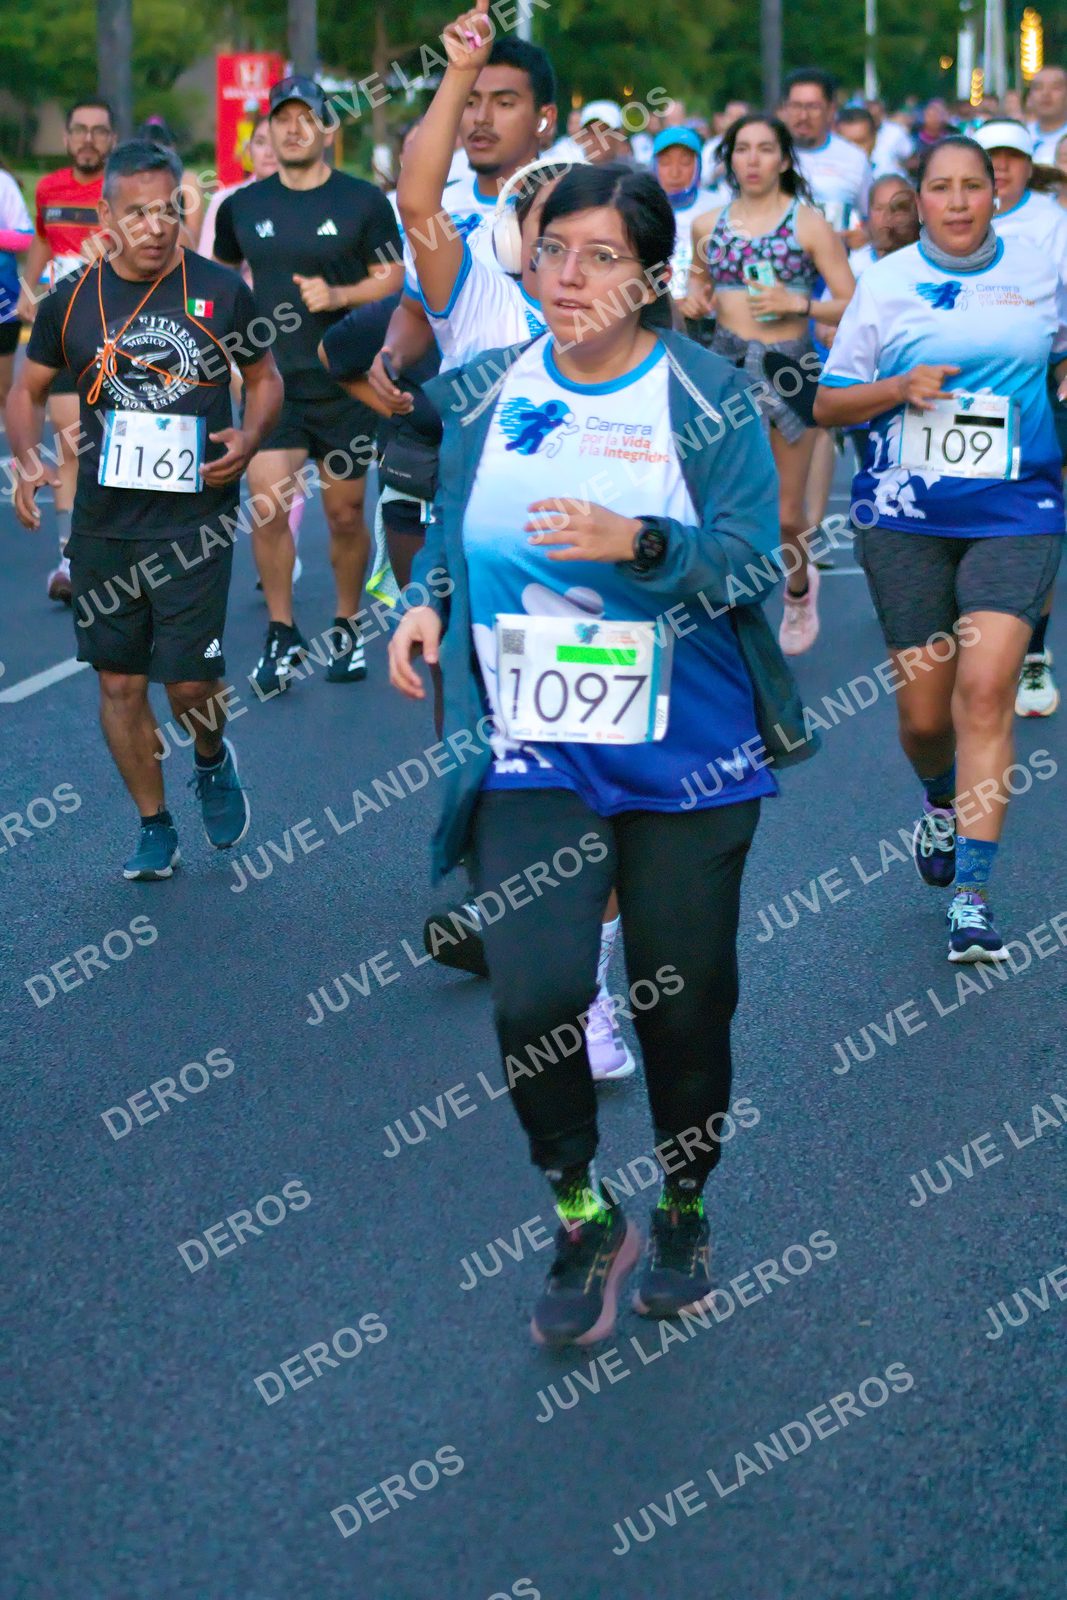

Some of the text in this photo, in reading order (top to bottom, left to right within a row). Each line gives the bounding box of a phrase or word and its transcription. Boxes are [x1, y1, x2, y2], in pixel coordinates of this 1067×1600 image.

[127, 336, 167, 349] MEXICO
[102, 375, 147, 409] UTDOOR
[586, 416, 652, 435] Carrera
[581, 434, 651, 449] por la Vida
[589, 445, 600, 455] la
[922, 427, 992, 465] 109
[115, 445, 194, 481] 1162
[510, 668, 648, 725] 1097
